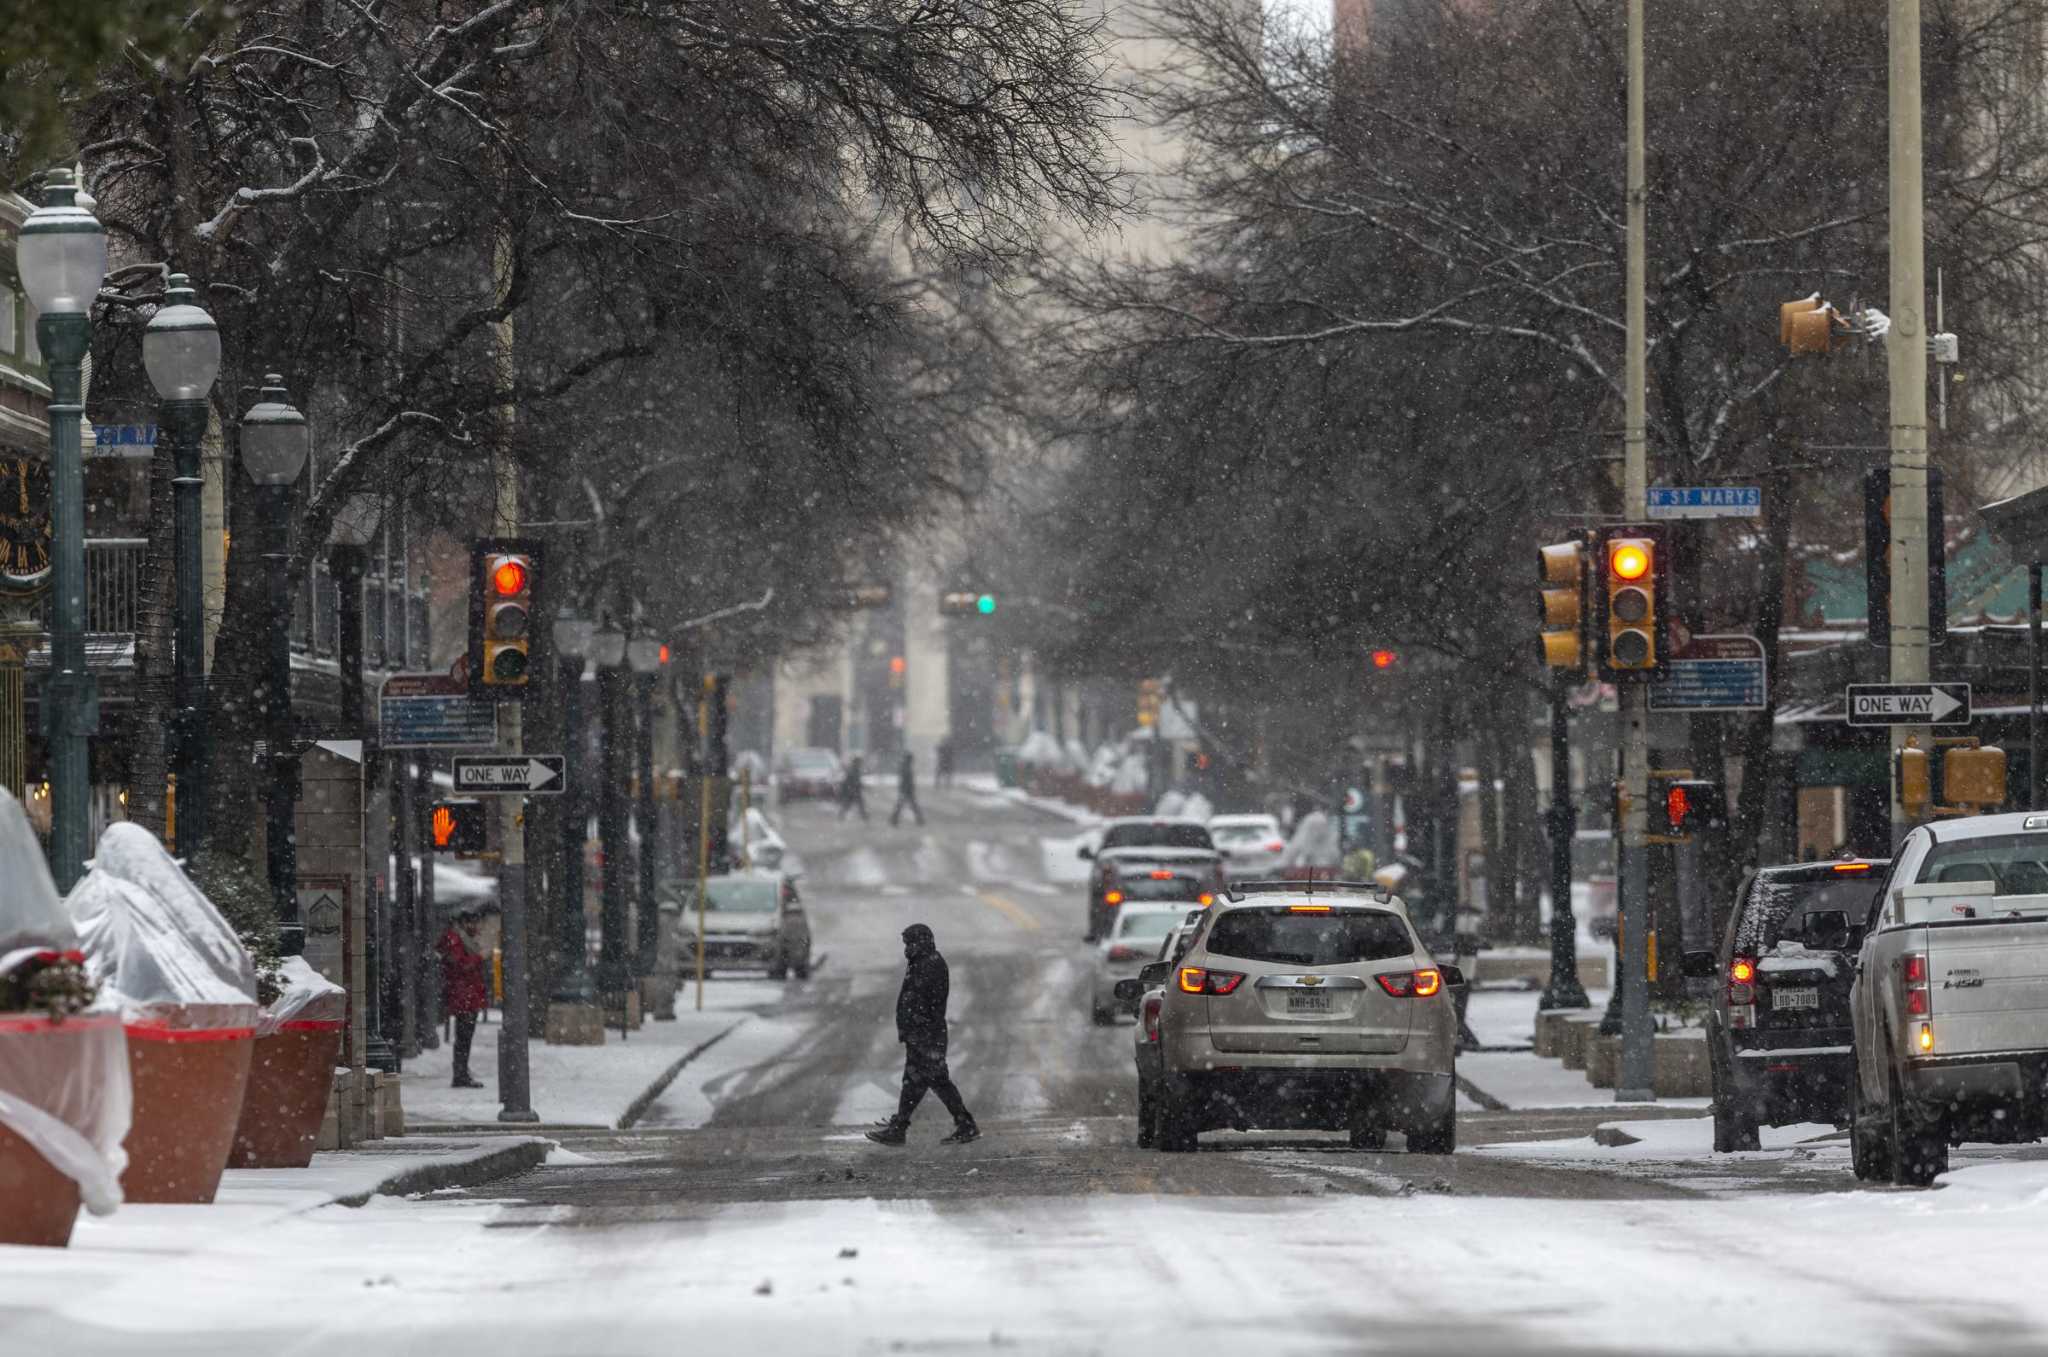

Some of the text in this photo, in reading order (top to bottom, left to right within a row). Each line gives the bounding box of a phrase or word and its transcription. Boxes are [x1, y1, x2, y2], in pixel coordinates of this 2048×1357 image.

[1650, 490, 1660, 504] N
[1701, 490, 1757, 504] MARYS
[1858, 697, 1932, 713] ONE WAY
[465, 768, 530, 782] ONE WAY
